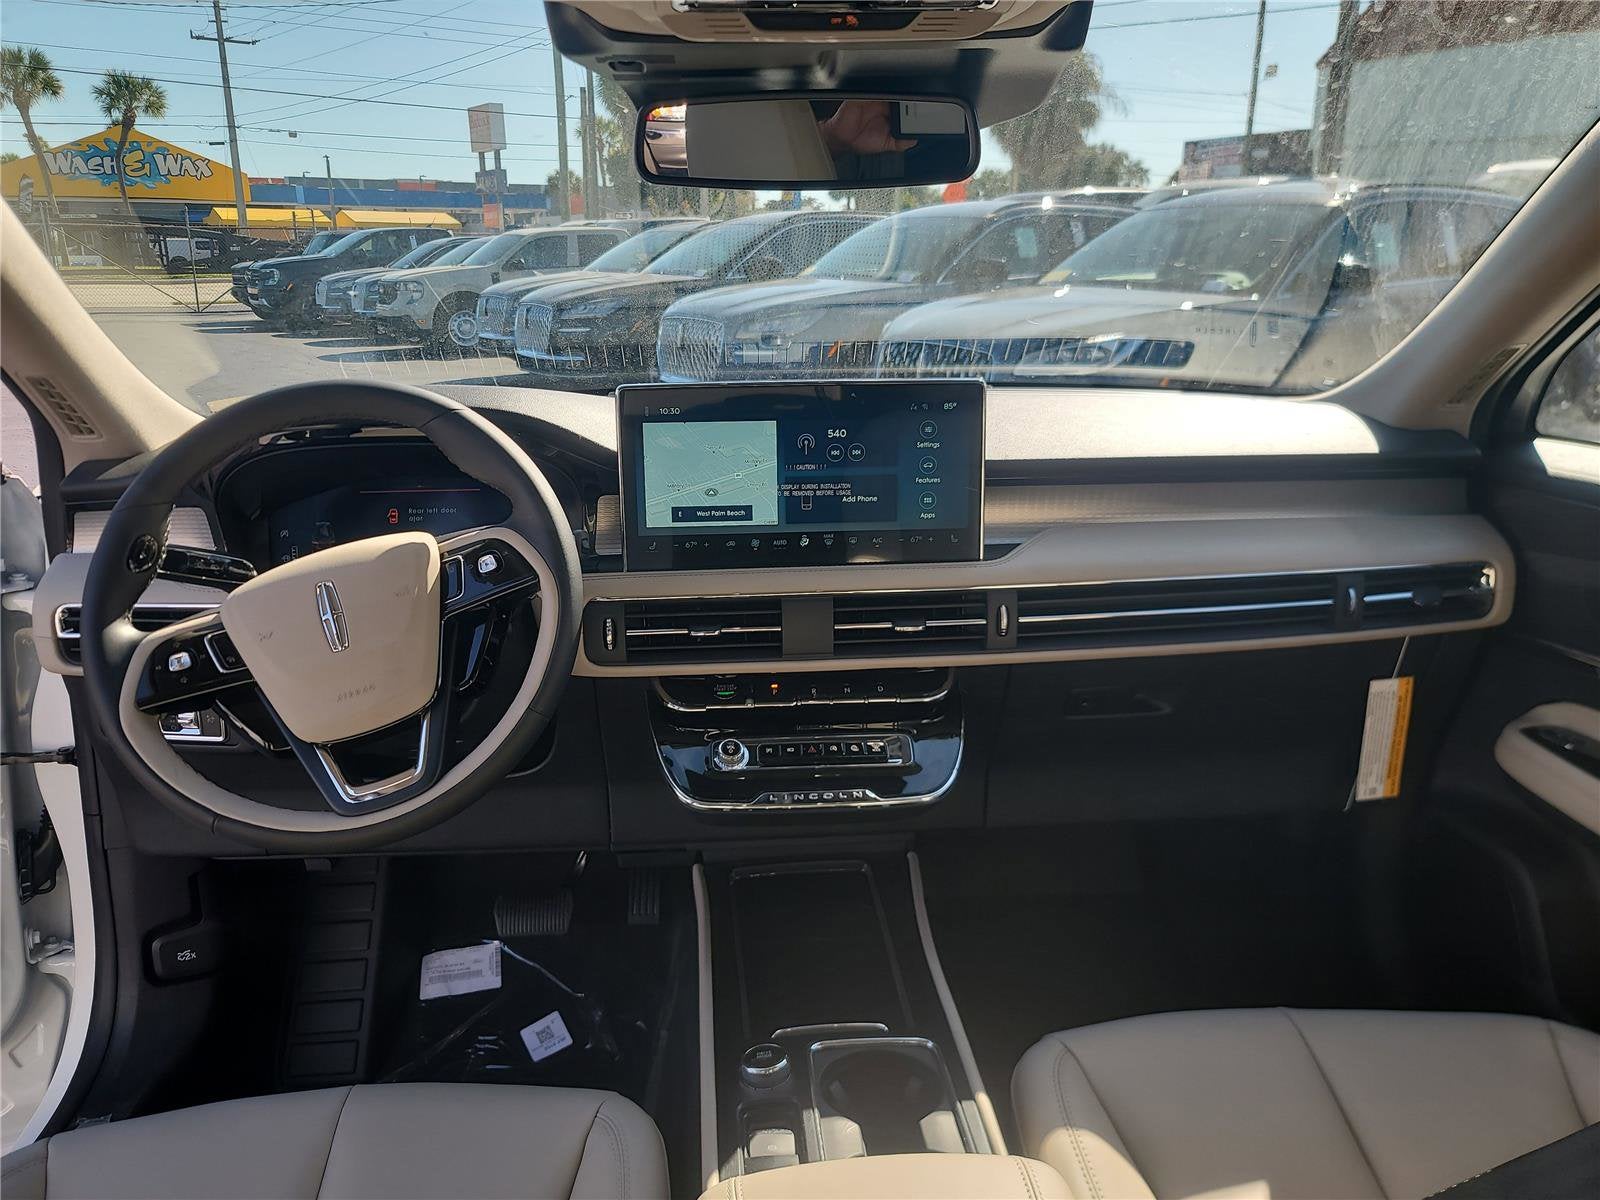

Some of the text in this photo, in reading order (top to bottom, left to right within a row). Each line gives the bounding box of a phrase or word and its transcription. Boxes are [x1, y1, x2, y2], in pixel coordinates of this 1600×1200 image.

[123, 149, 150, 178] &
[659, 407, 681, 415] 10:30
[827, 429, 847, 438] 540
[916, 441, 941, 449] Settings
[915, 476, 941, 484] Features
[842, 495, 878, 503] Add Phone
[727, 509, 746, 517] Beach
[919, 512, 936, 520] Apps
[872, 536, 883, 544] A/C
[769, 790, 863, 801] LINCOLN
